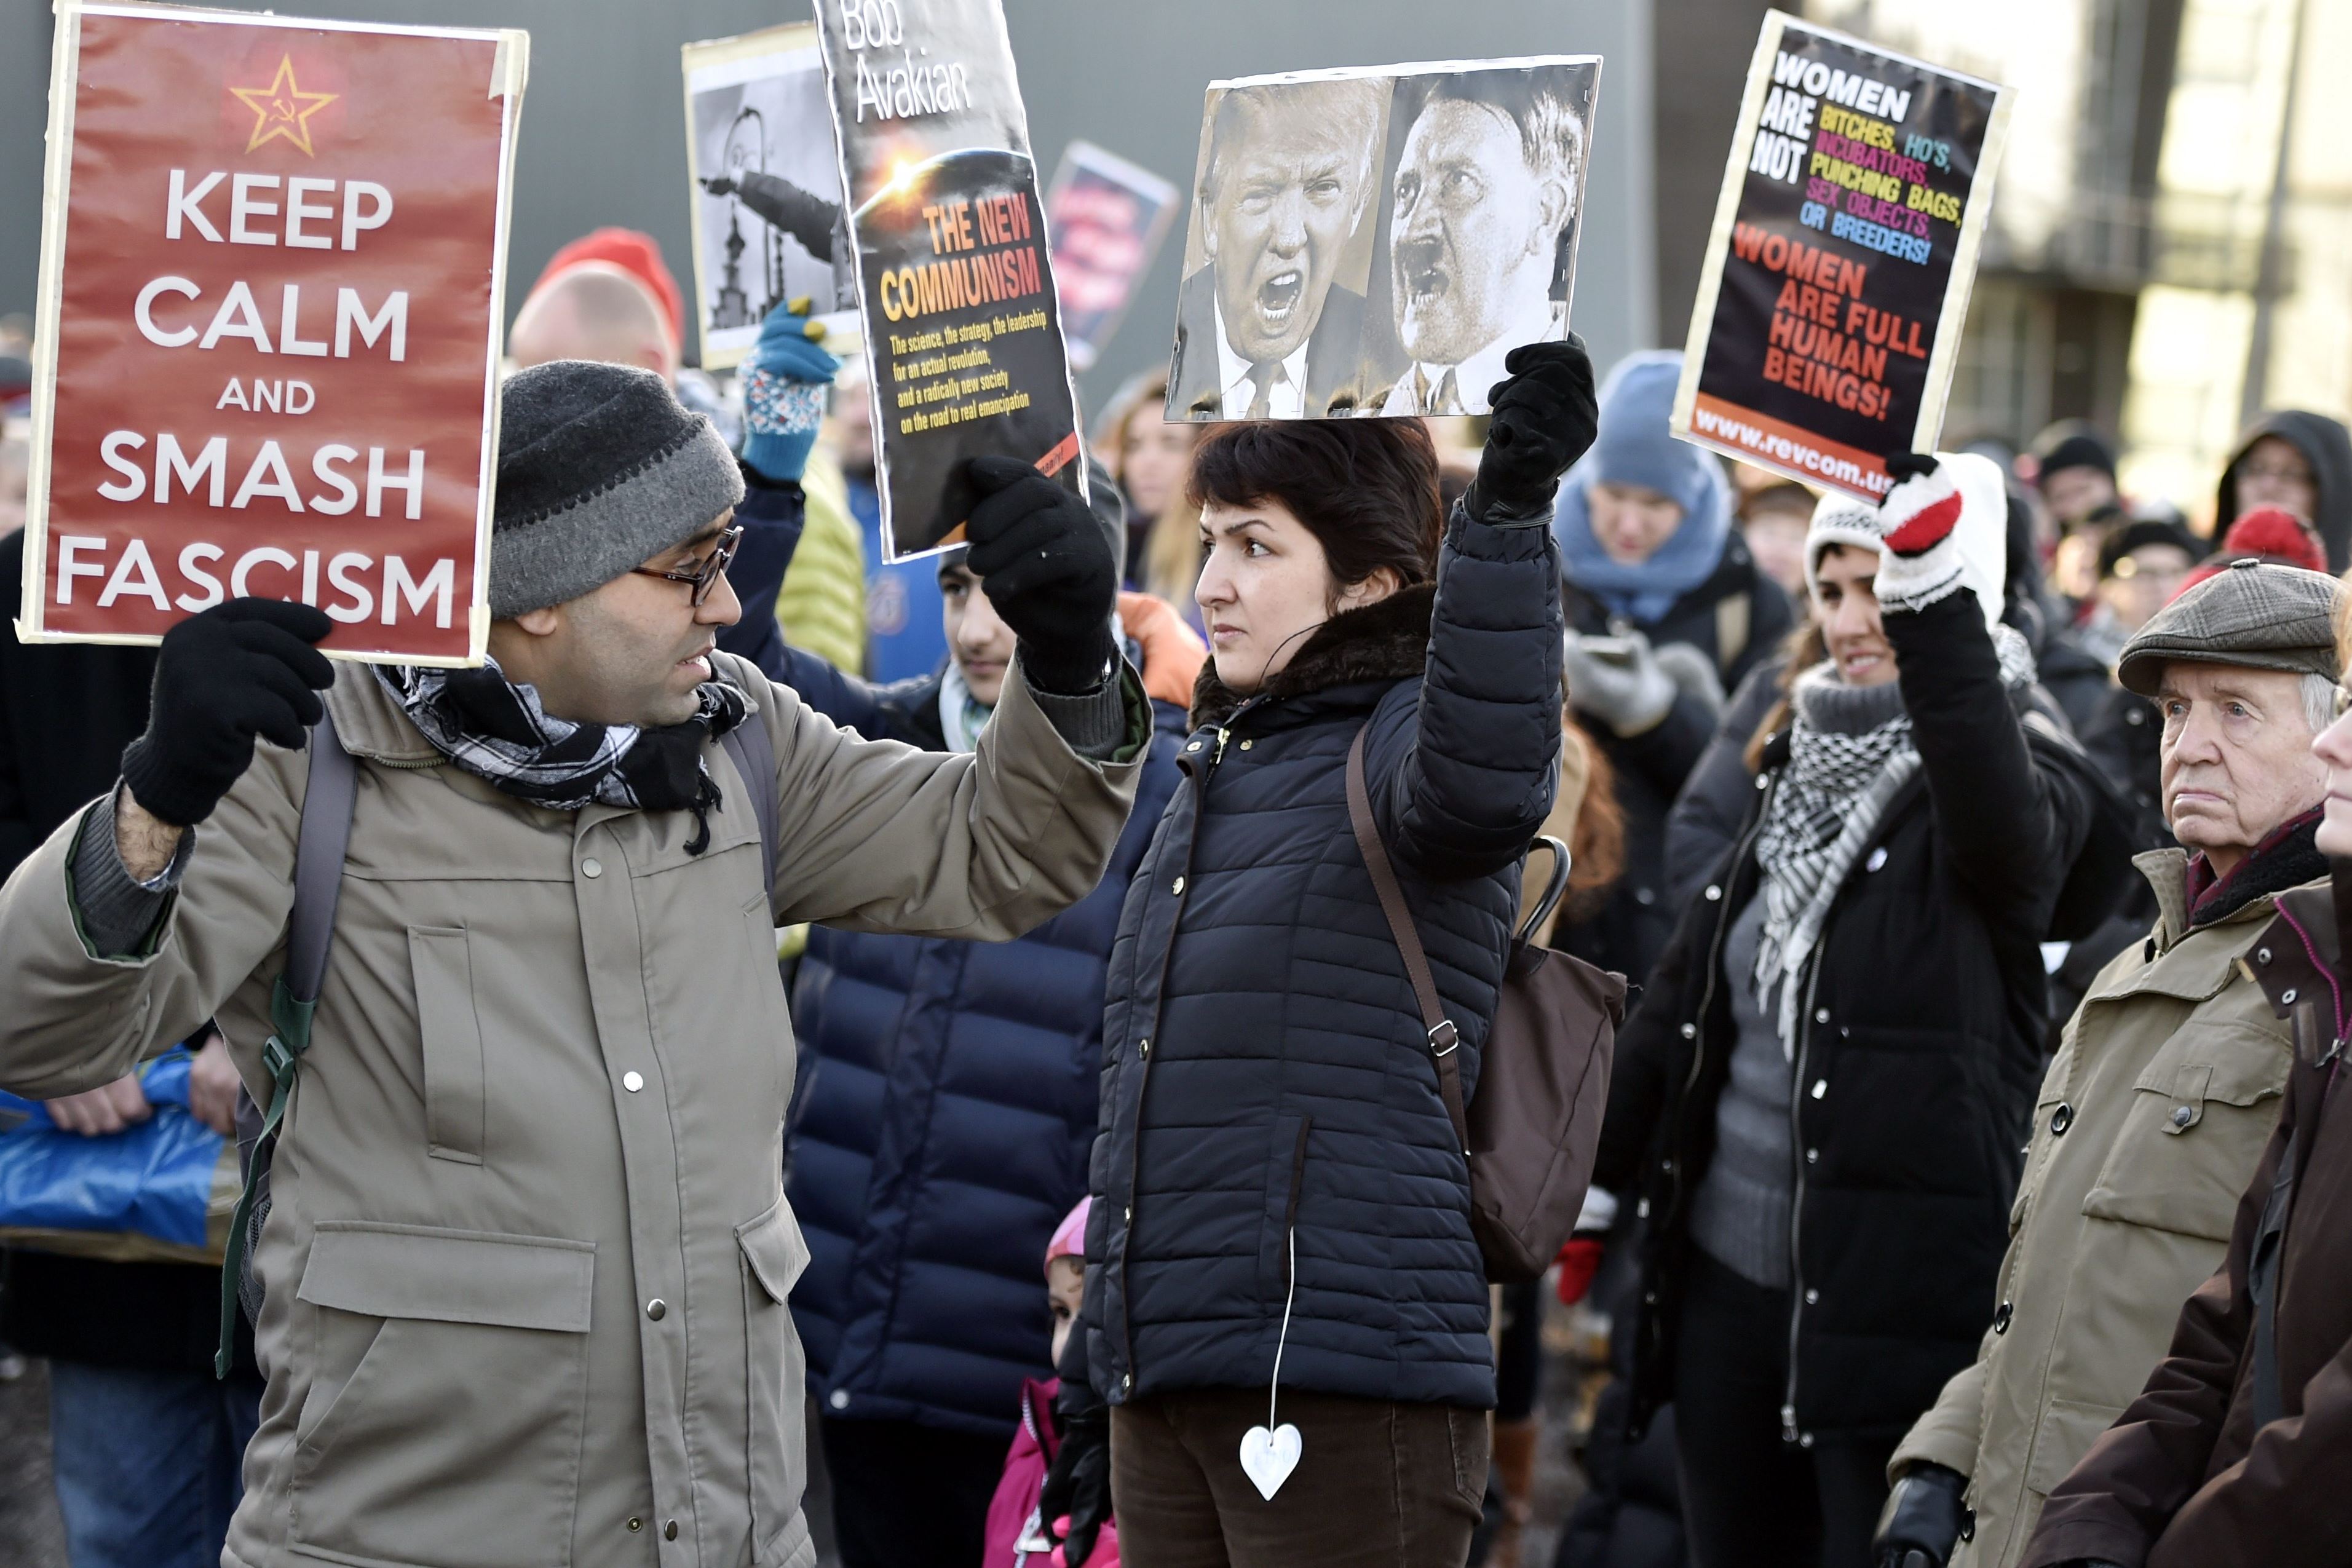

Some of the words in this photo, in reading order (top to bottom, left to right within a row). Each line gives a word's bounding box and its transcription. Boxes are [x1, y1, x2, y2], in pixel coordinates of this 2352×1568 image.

[840, 0, 903, 50] Bob
[857, 47, 971, 123] Avakian
[1760, 85, 1817, 141] ARE
[1773, 50, 1911, 123] WOMEN
[1750, 129, 1808, 184] NOT
[1805, 177, 1840, 208] SEX
[1809, 152, 1901, 204] PUNCHING
[1906, 183, 1962, 229] BAGS,
[165, 168, 393, 251] KEEP
[922, 201, 975, 255] THE
[976, 192, 1031, 245] NEW
[1799, 202, 1827, 231] OR
[1831, 212, 1933, 265] BREEDERS!
[880, 246, 1041, 322] COMMUNISM
[1732, 223, 1867, 299] WOMEN
[133, 275, 408, 362] CALM
[890, 335, 907, 355] The
[908, 331, 944, 352] science,
[944, 326, 957, 345] the
[959, 320, 992, 342] strategy,
[992, 316, 1007, 335] the
[1006, 308, 1047, 334] leadership
[1768, 311, 1888, 384] HUMAN
[1776, 279, 1841, 330] ARE
[1845, 301, 1926, 359] FULL
[215, 377, 315, 415] AND
[893, 362, 906, 382] for
[908, 364, 920, 379] an
[921, 354, 947, 376] actual
[948, 347, 991, 370] revolution,
[897, 387, 914, 408] and
[916, 390, 922, 404] a
[923, 378, 959, 402] radically
[960, 380, 978, 395] new
[980, 370, 1008, 391] society
[1762, 345, 1892, 422] BEINGS!
[900, 418, 913, 434] on
[913, 411, 928, 432] the
[929, 406, 949, 429] road
[950, 407, 959, 424] to
[960, 400, 977, 421] real
[978, 390, 1030, 418] emancipation
[97, 429, 425, 520] SMASH
[56, 536, 455, 629] FASCISM
